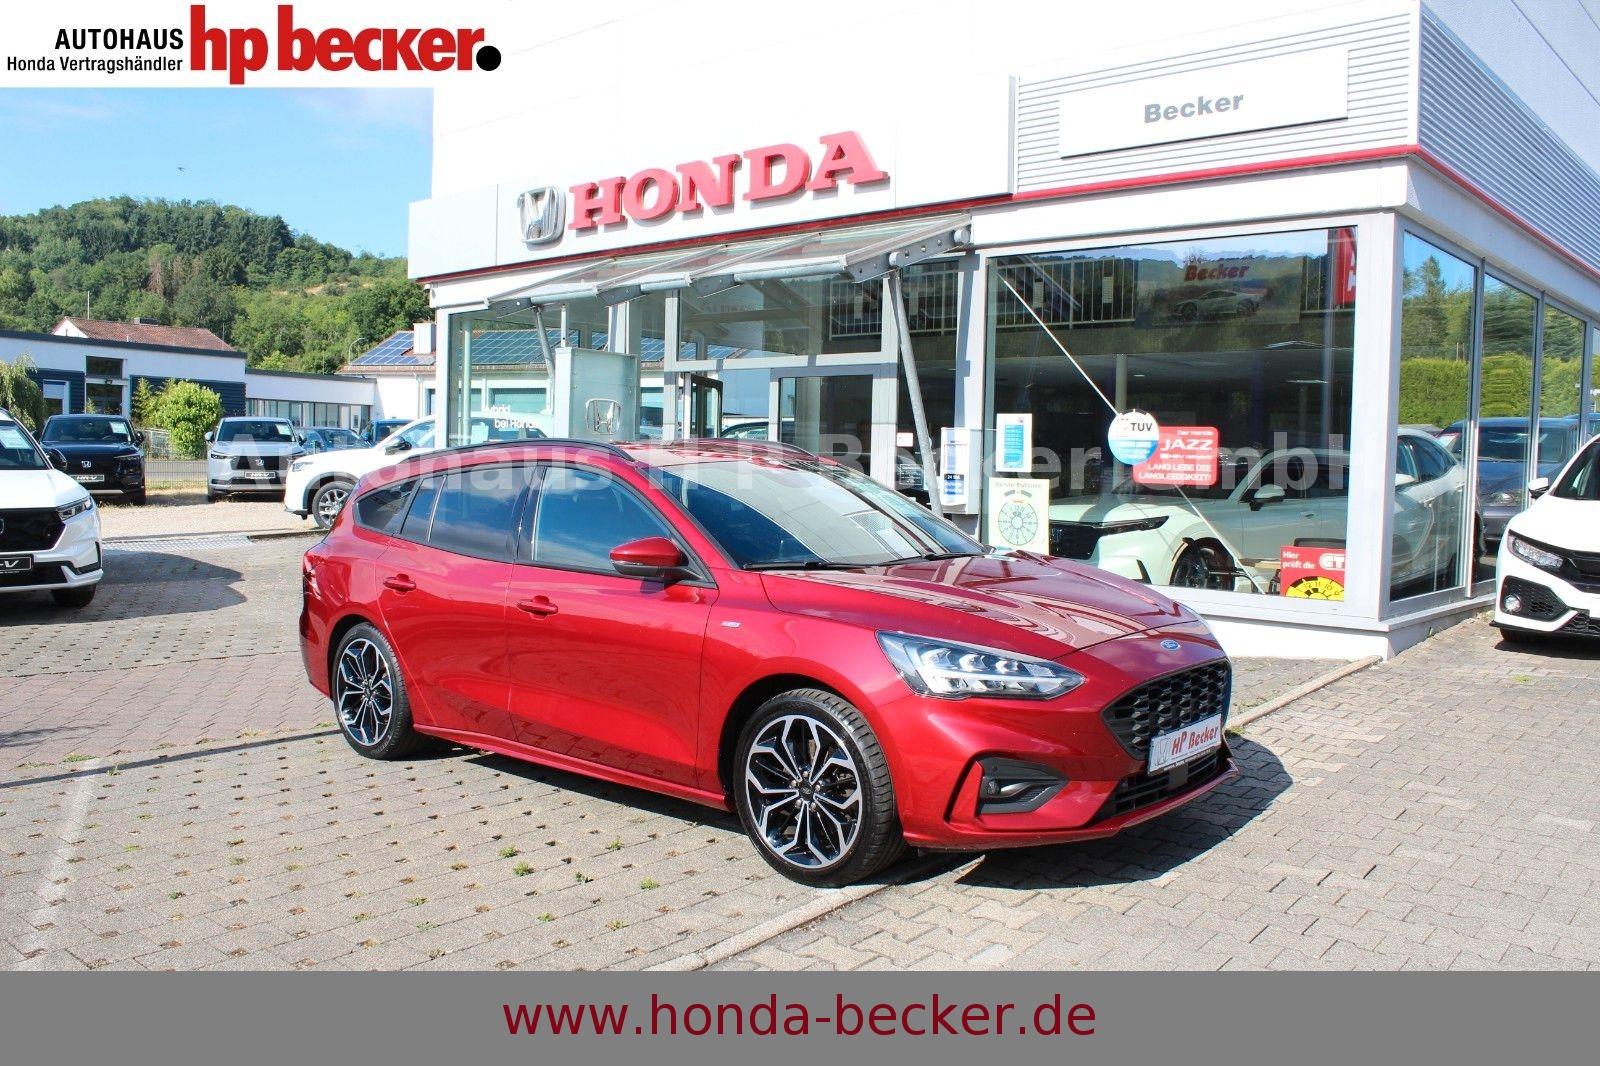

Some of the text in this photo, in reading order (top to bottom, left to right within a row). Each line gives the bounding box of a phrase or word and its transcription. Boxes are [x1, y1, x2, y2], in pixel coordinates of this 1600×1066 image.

[1144, 93, 1244, 124] Becker
[568, 129, 890, 232] HONDA
[1184, 254, 1250, 282] Becker
[1160, 439, 1214, 451] JAZZ
[1147, 463, 1171, 471] LANG
[1196, 464, 1212, 472] DIE
[1282, 560, 1316, 570] prüft die
[1283, 551, 1299, 559] Hier
[1171, 726, 1219, 756] HP Becker
